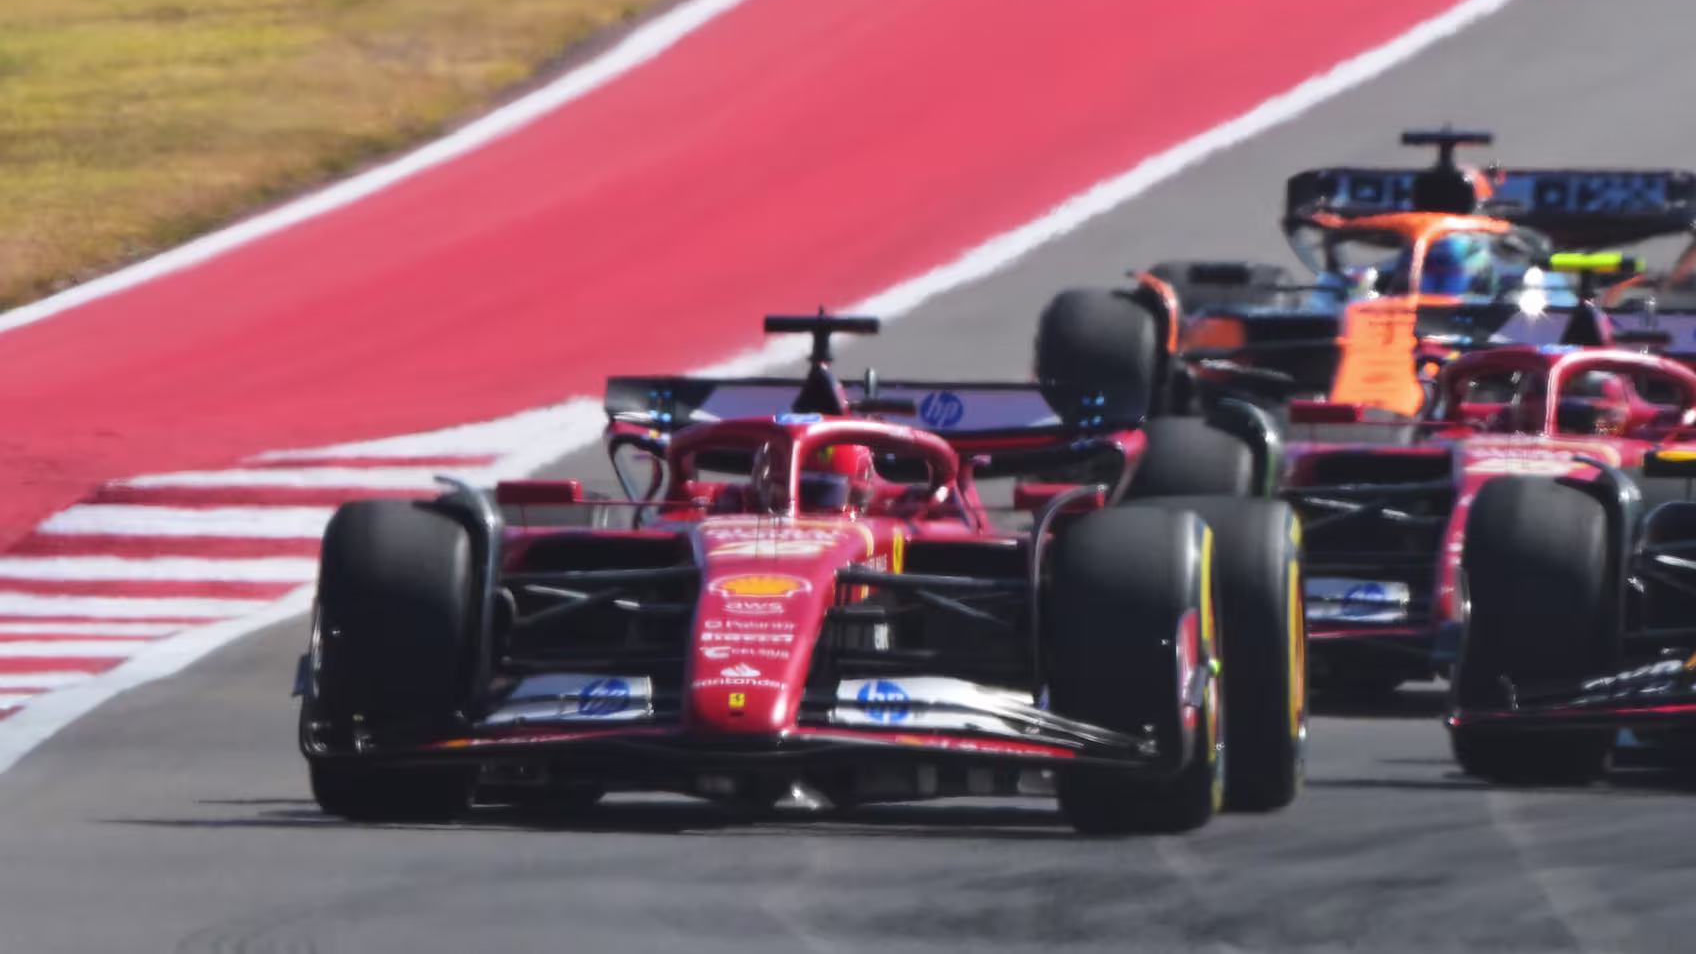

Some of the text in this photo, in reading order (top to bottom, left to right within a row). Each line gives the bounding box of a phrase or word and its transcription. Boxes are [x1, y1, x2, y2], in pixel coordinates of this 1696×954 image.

[924, 390, 962, 428] hp
[724, 602, 783, 612] aws
[860, 681, 910, 724] hp
